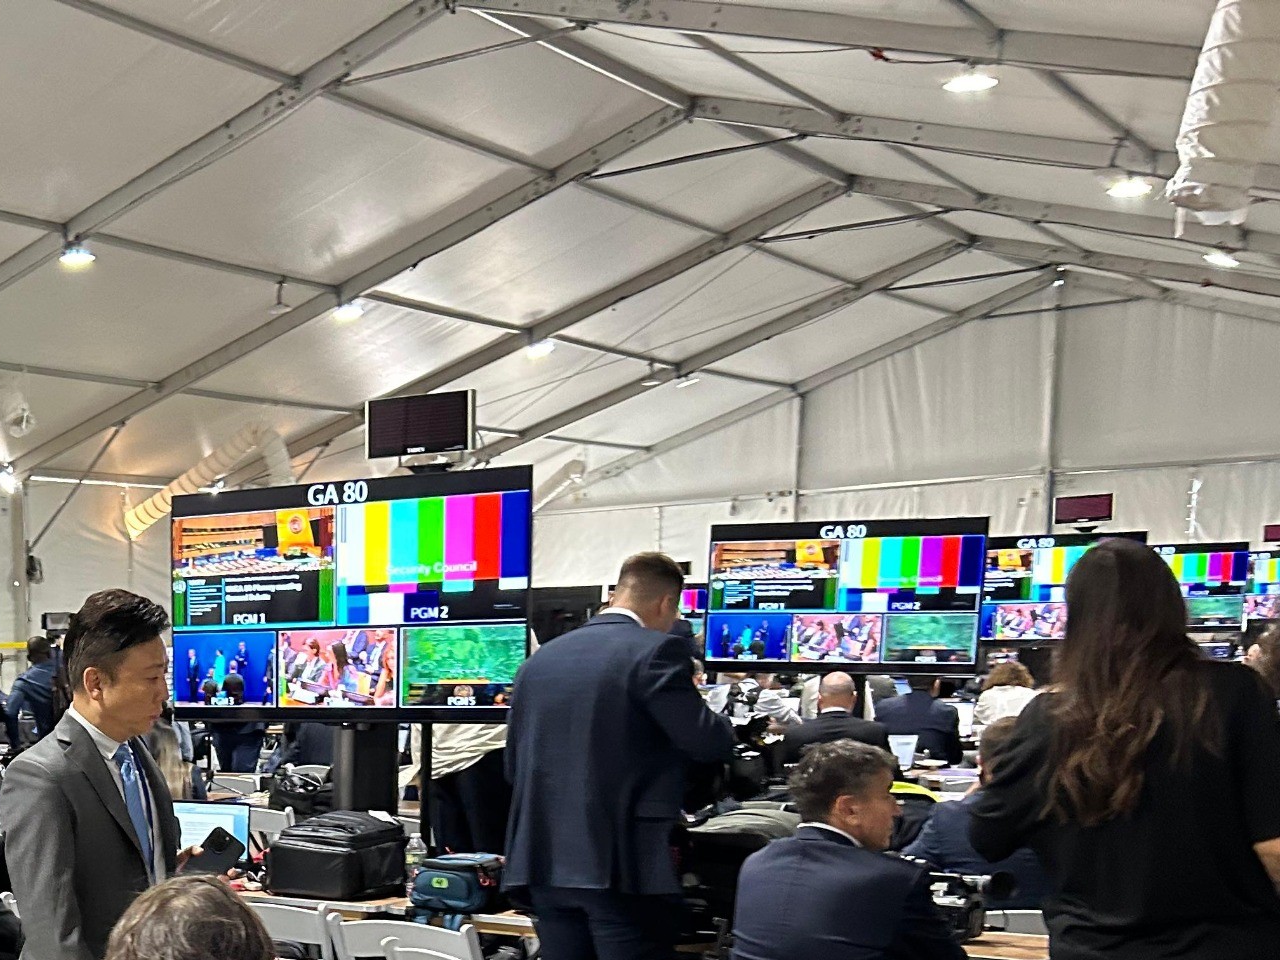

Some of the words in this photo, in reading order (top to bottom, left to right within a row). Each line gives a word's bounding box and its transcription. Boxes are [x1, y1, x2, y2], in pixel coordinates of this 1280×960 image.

[307, 484, 339, 506] GA
[342, 481, 369, 503] 80
[819, 525, 846, 539] GA
[847, 524, 867, 538] 80
[1017, 538, 1037, 549] GA
[387, 563, 431, 576] Security
[433, 560, 478, 573] Council
[233, 613, 258, 625] PGM
[259, 612, 266, 624] 1
[410, 607, 439, 619] PGM
[439, 606, 449, 619] 2
